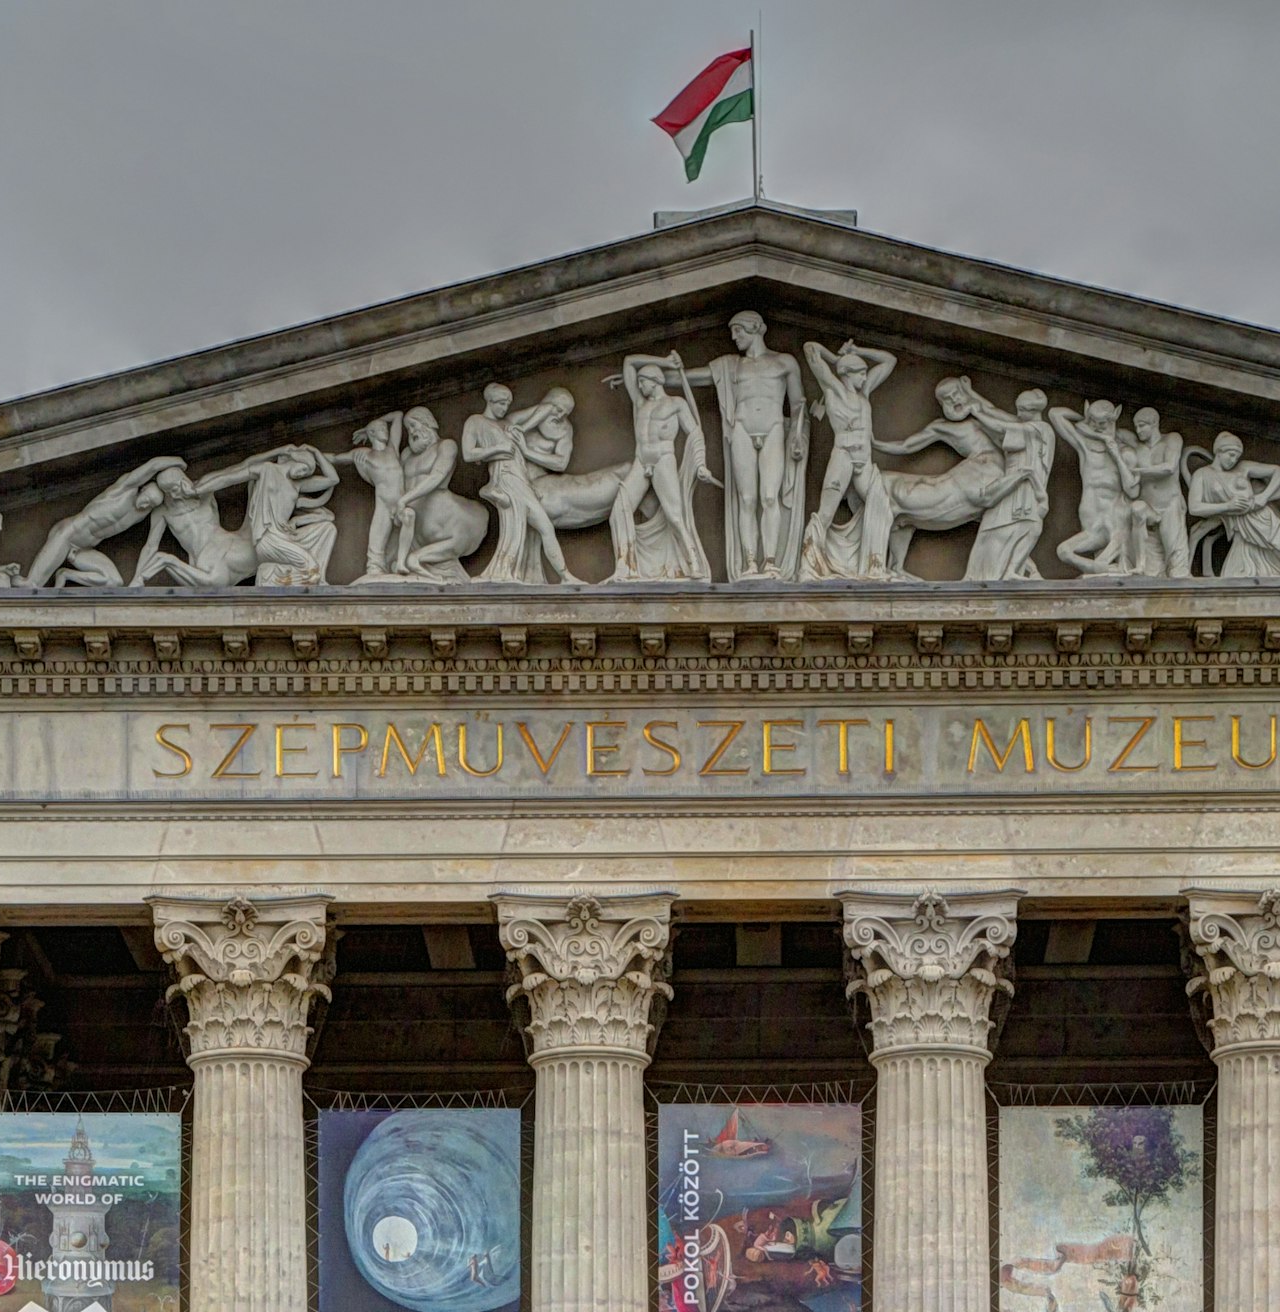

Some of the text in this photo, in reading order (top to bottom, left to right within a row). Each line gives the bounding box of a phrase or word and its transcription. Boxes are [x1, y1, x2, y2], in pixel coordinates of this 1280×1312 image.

[14, 1175, 145, 1187] THE ENIGMATIC
[679, 1129, 700, 1221] KÖZÖTT
[35, 1193, 124, 1205] WORLD OF
[3, 1253, 155, 1288] Hieronymus
[684, 1229, 700, 1304] POKOL
